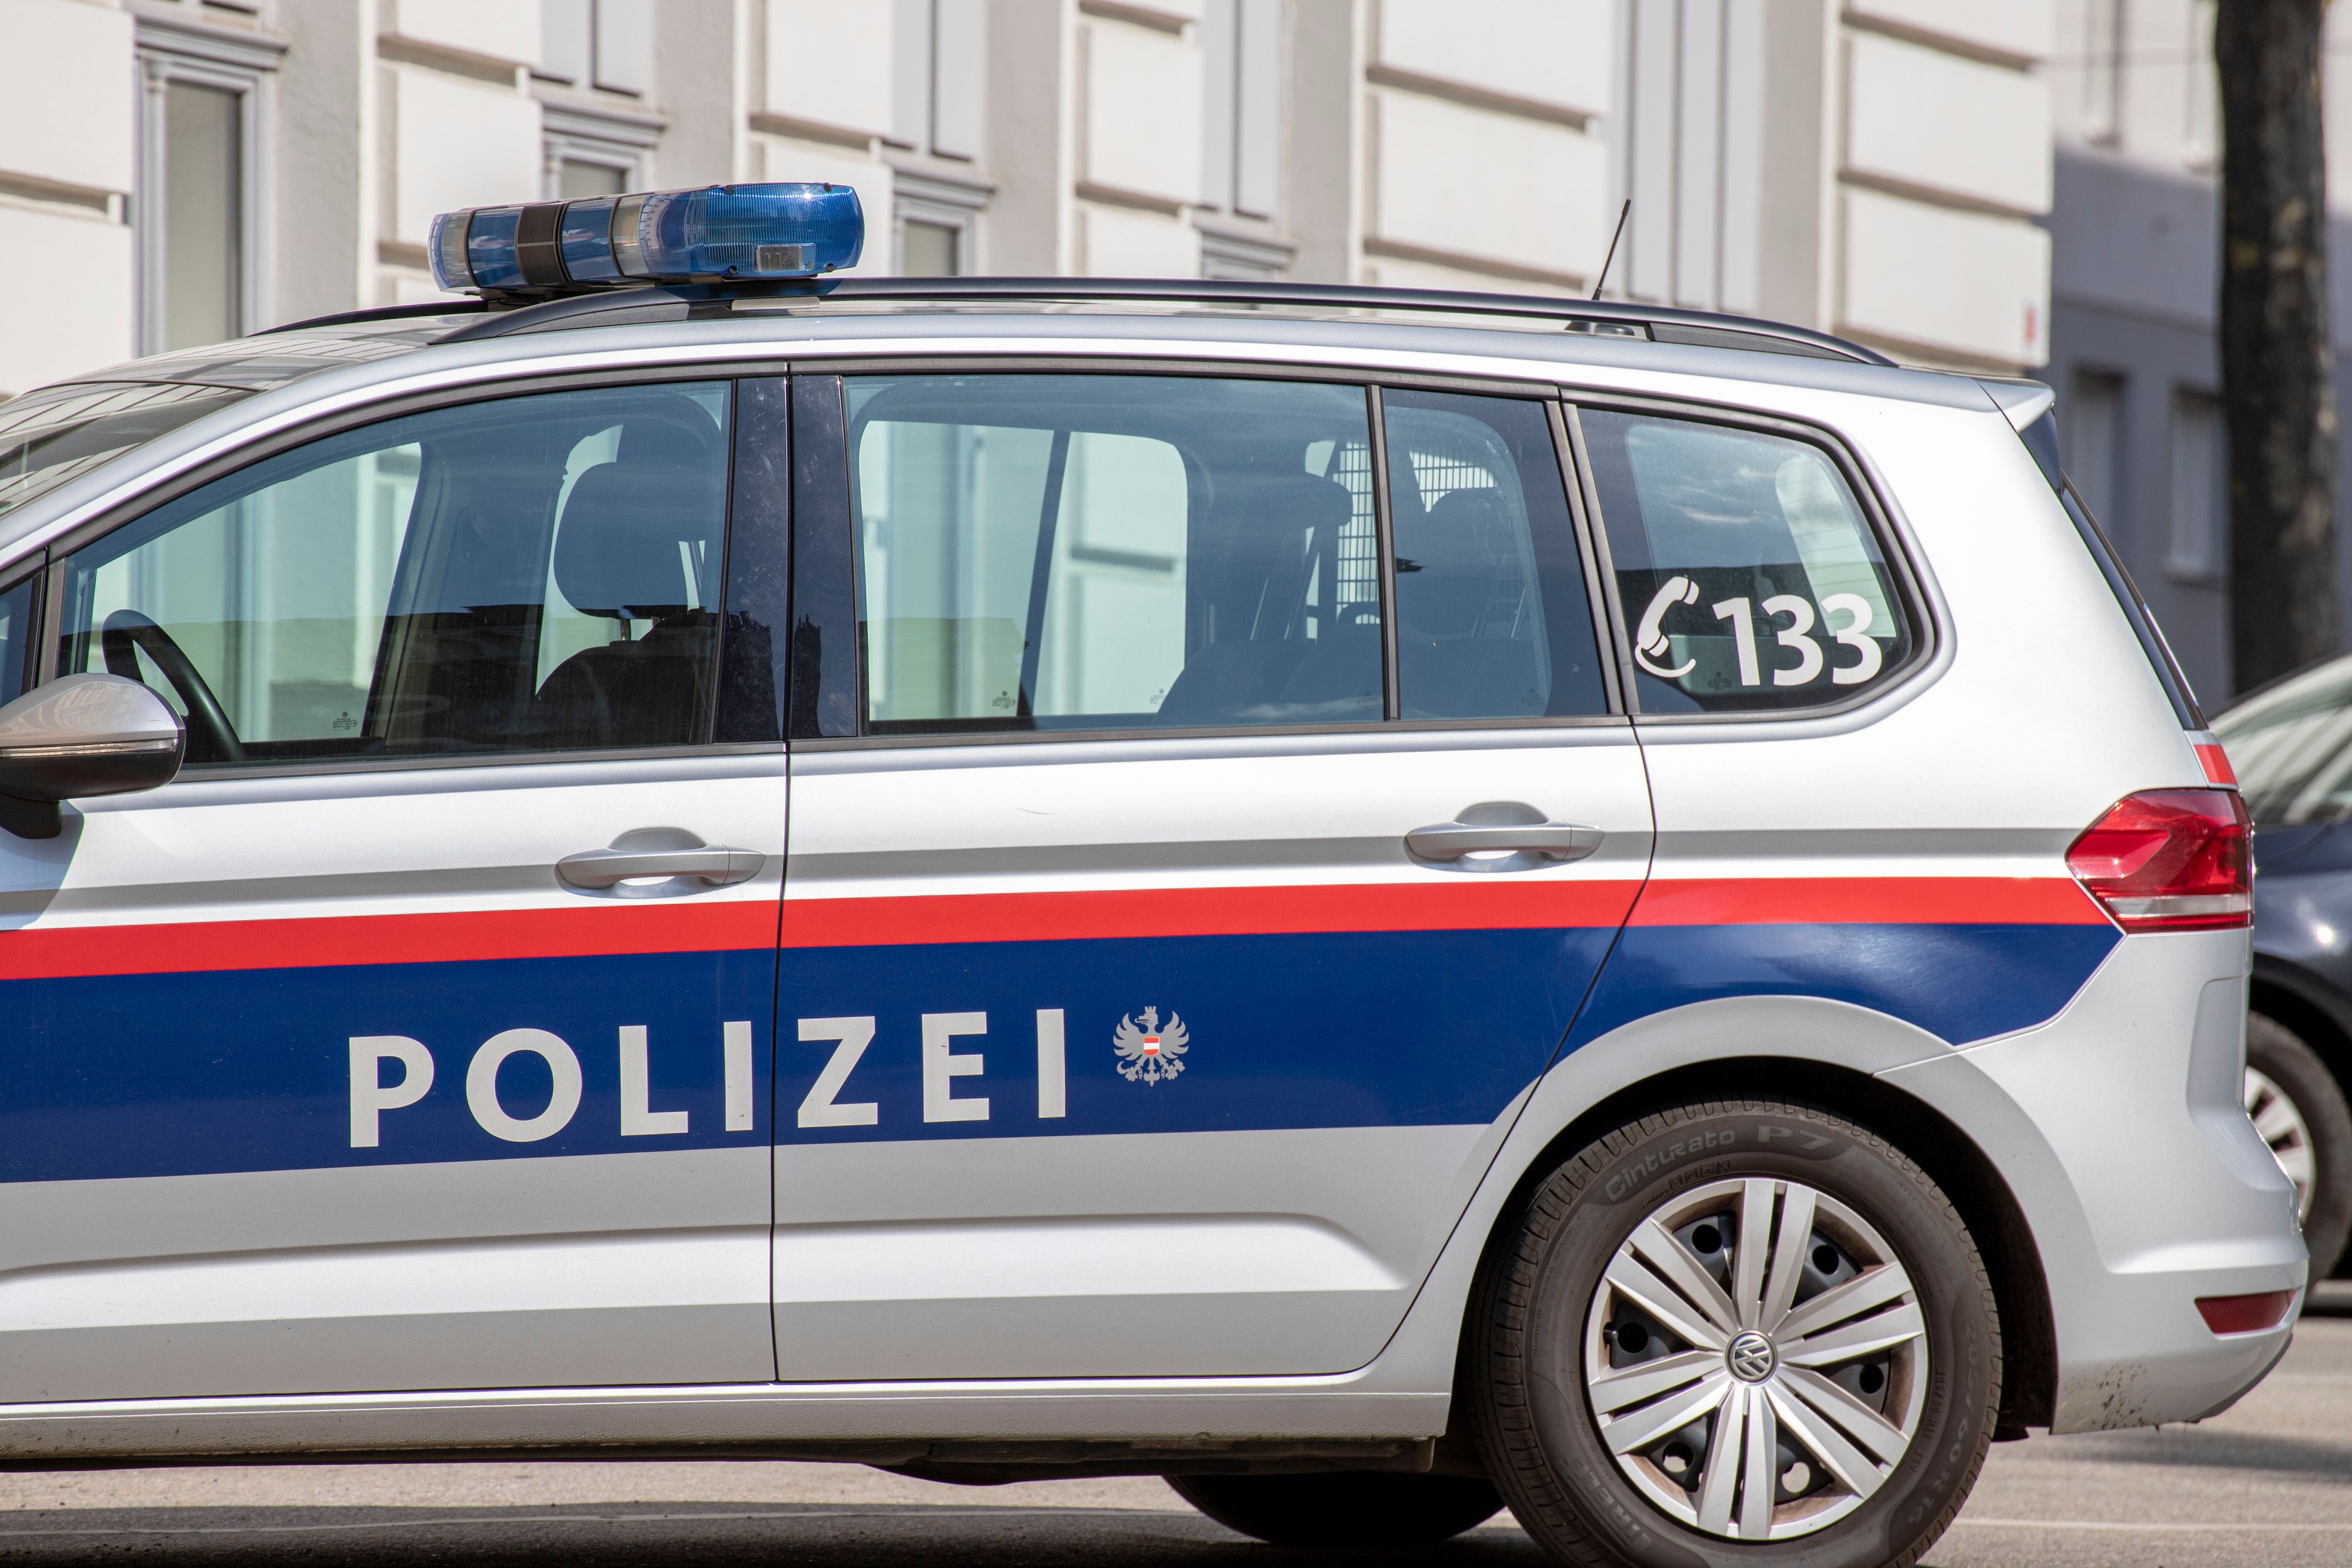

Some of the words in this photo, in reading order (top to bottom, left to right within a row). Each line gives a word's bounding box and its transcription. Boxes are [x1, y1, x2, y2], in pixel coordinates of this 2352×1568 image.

[1712, 593, 1882, 686] 133
[349, 1009, 1065, 1148] POLIZEI
[1605, 1128, 1736, 1202] Cinturato
[1758, 1124, 1835, 1151] P7
[1907, 1467, 1951, 1525] R16
